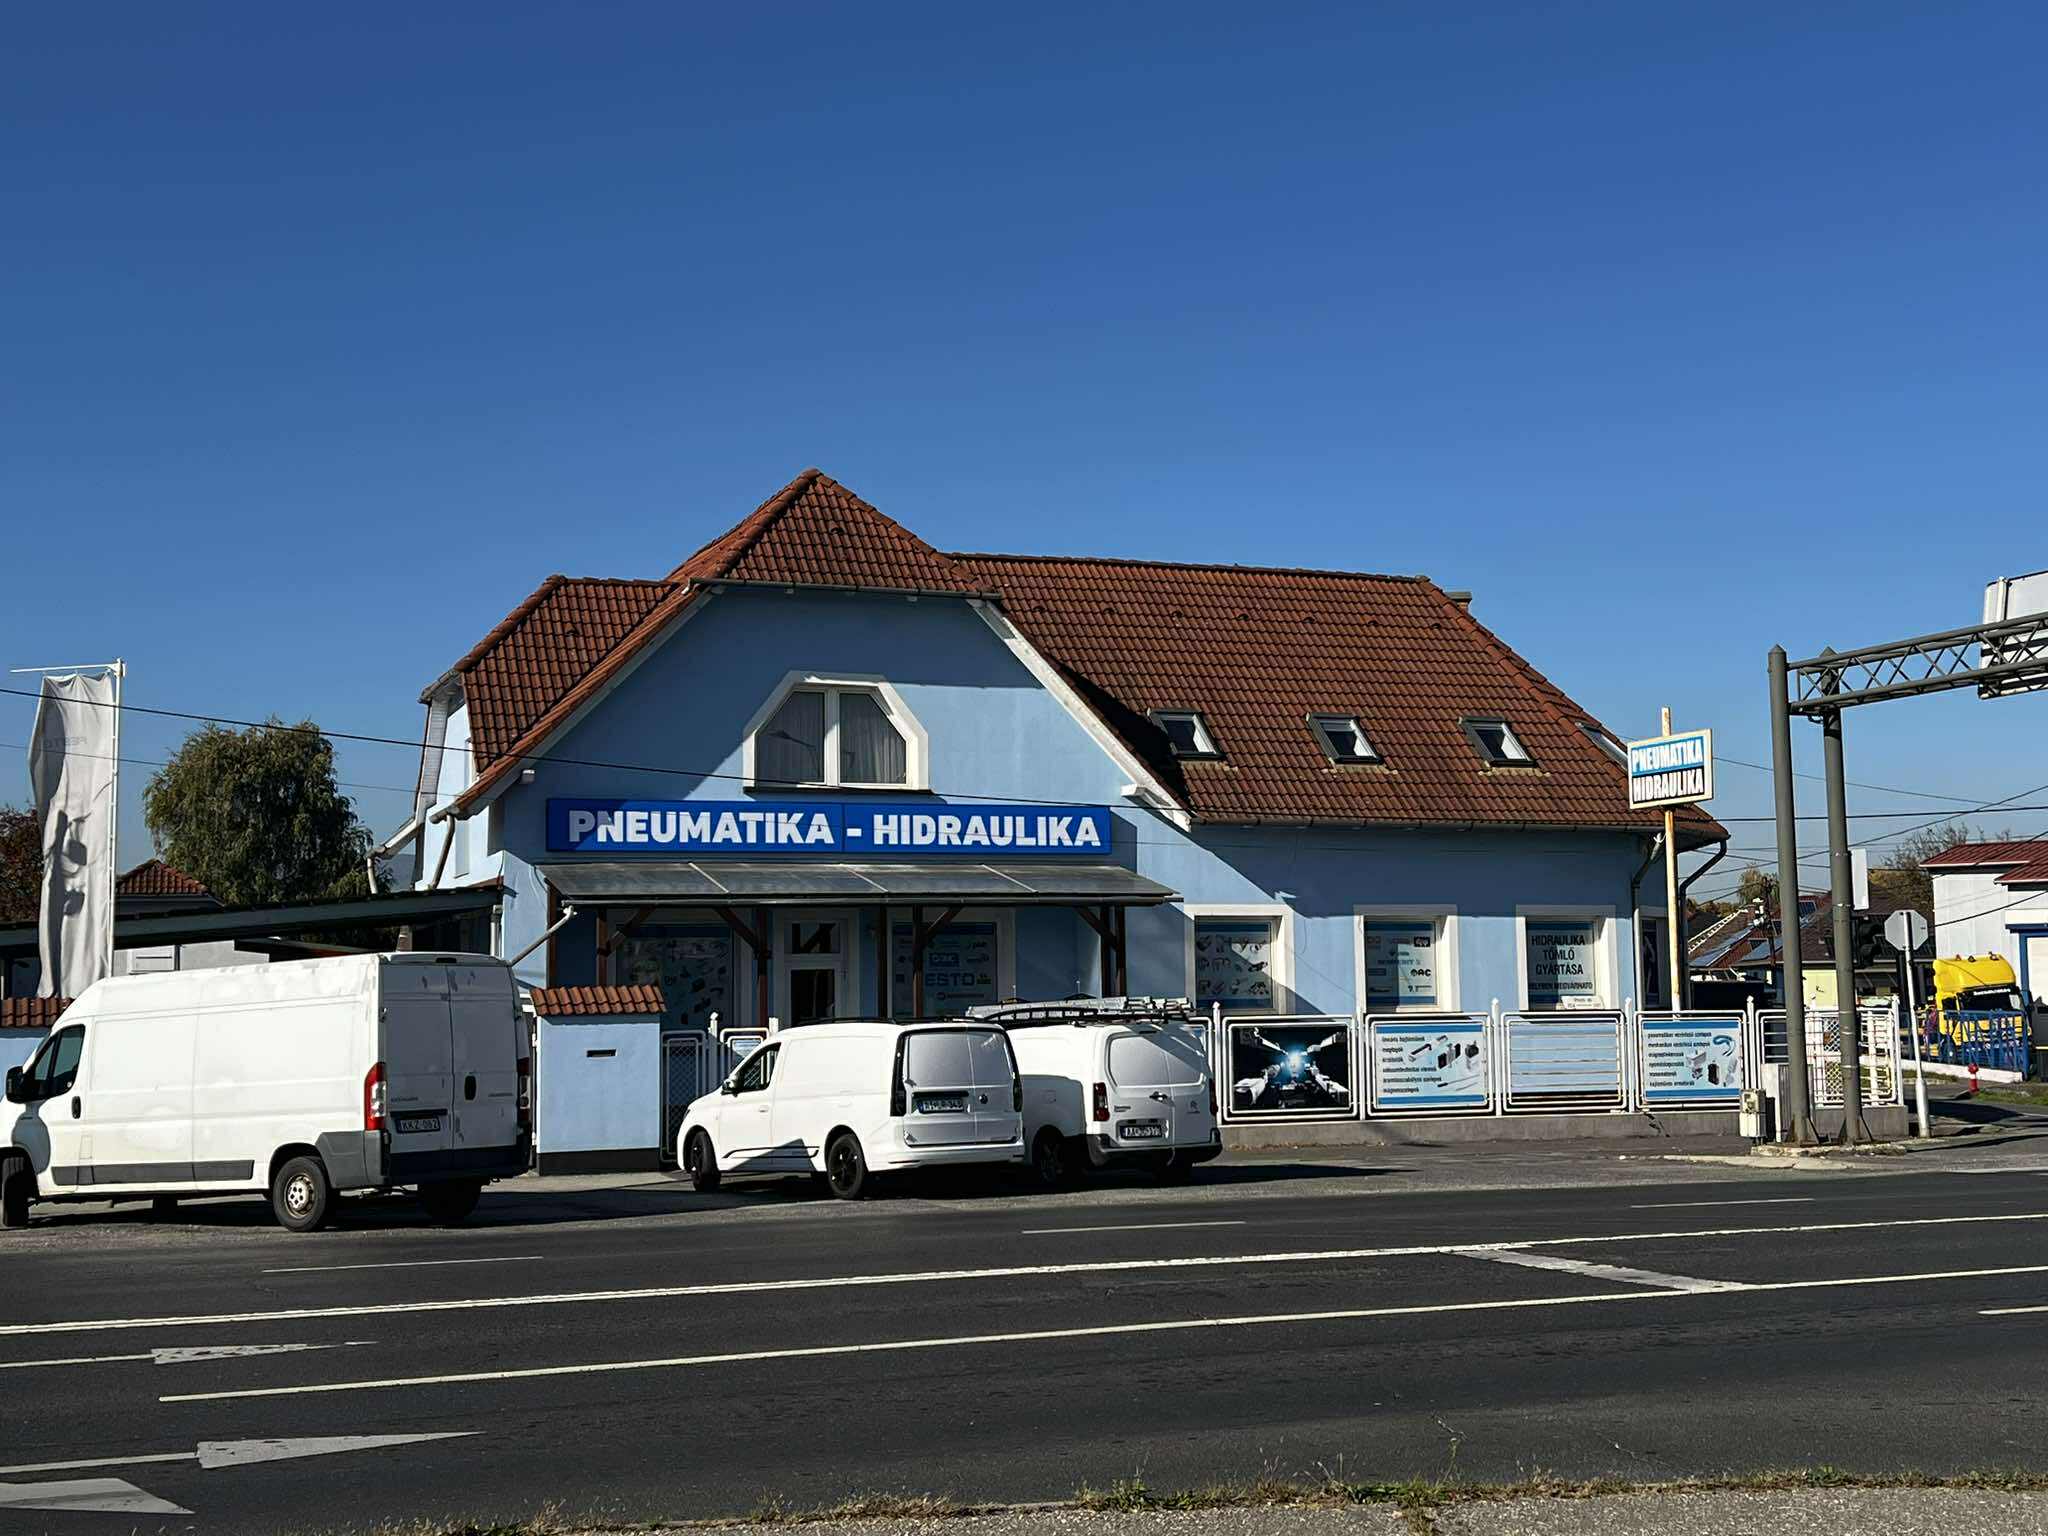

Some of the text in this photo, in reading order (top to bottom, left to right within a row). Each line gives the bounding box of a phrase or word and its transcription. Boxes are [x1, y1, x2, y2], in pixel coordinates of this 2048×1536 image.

[1632, 739, 1703, 773] PNEUMATIKA
[1633, 768, 1704, 802] HIDRAULIKA
[569, 810, 1101, 846] PNEUMATIKA - HIDRAULIKA
[1531, 934, 1585, 946] HIDRAULIKA
[1543, 946, 1575, 960] TÖMLŐ
[925, 972, 975, 986] ESTO
